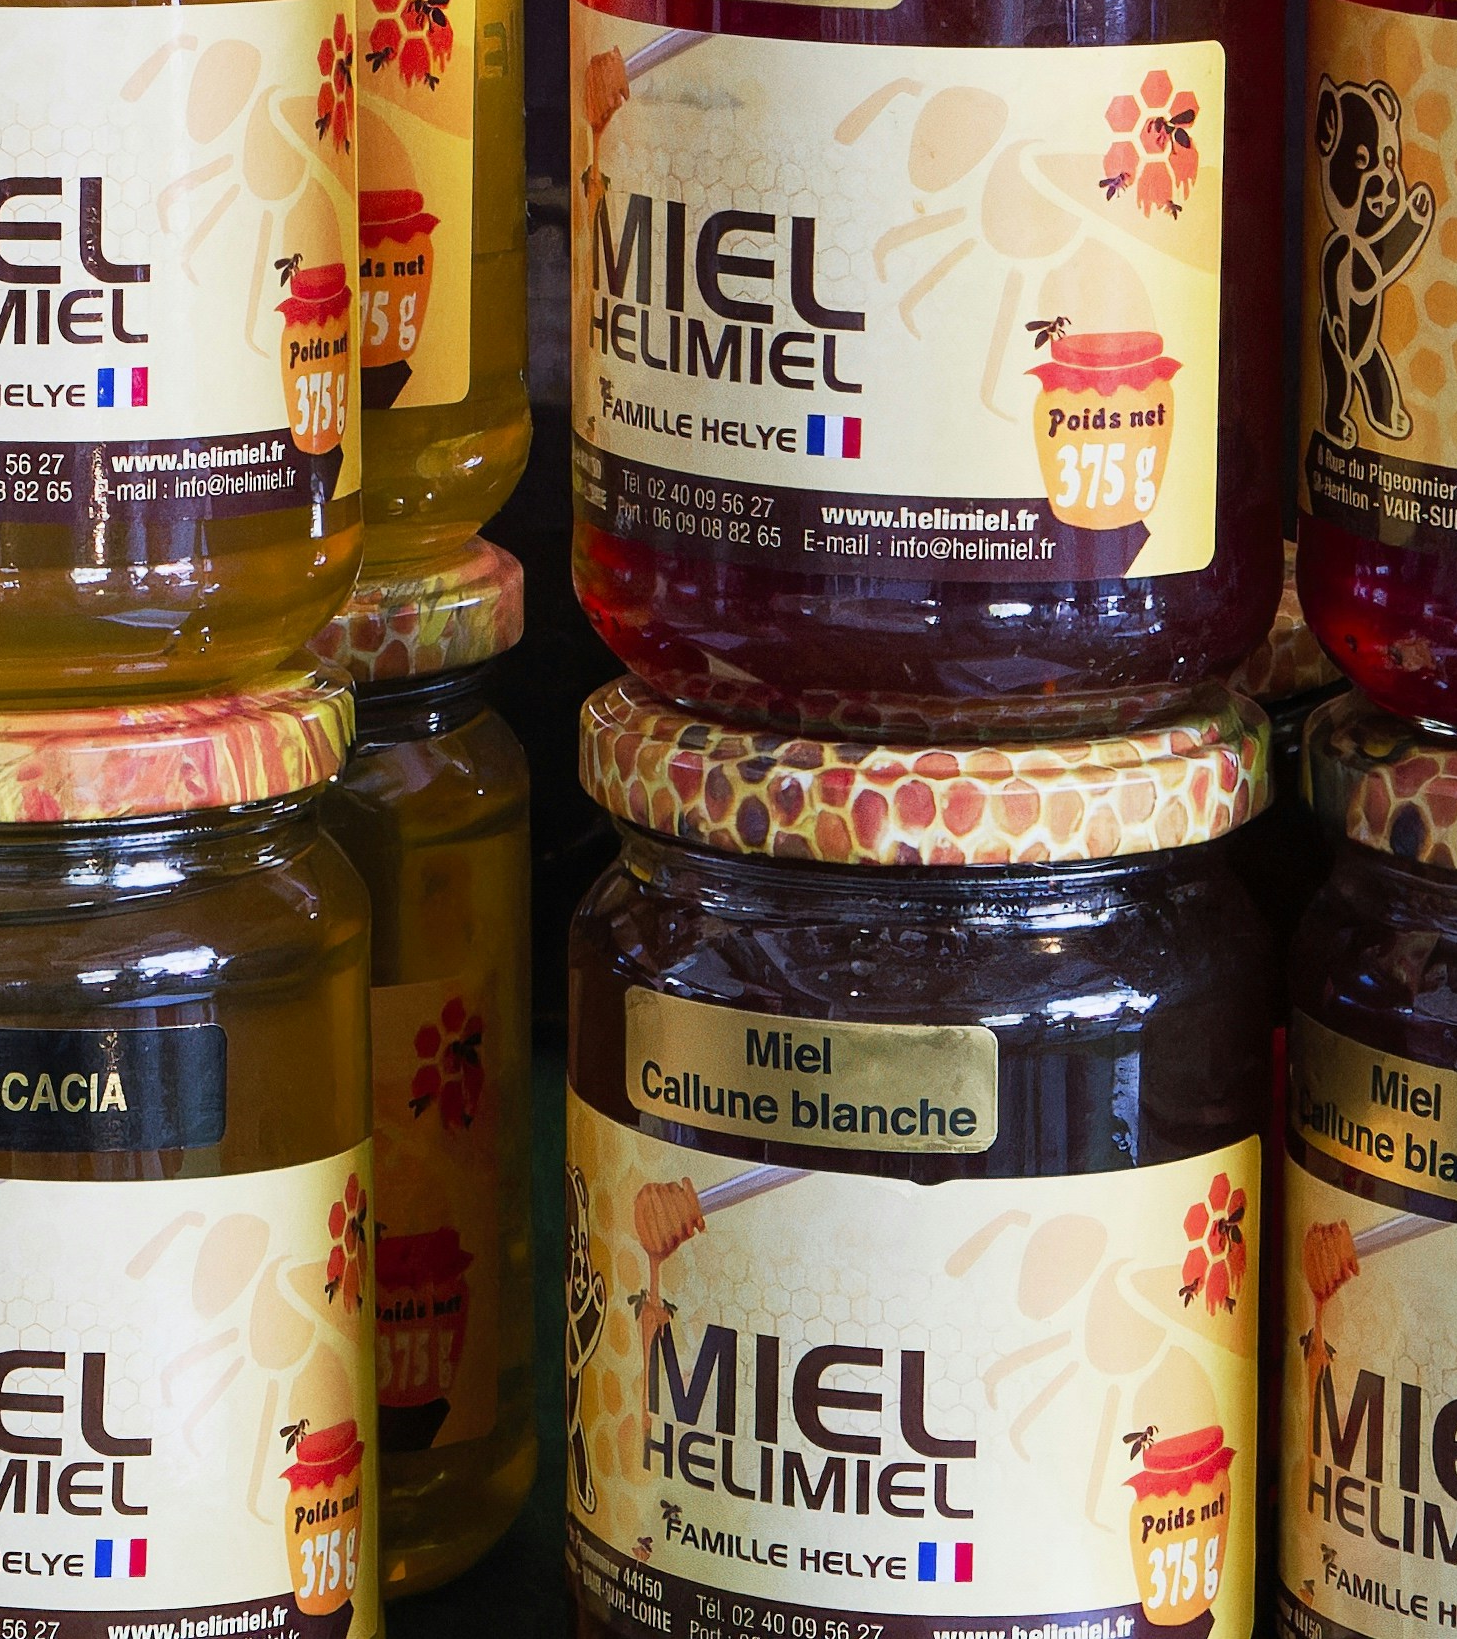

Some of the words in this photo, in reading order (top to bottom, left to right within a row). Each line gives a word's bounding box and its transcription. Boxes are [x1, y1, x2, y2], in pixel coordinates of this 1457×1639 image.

[593, 193, 865, 331] MIEL
[589, 298, 862, 394] HELIMIEL
[602, 395, 692, 440] FAMILLE
[703, 417, 796, 453] HELYE
[1049, 408, 1121, 438] Poids
[1130, 403, 1165, 429] net
[1055, 445, 1125, 509] 375
[1135, 444, 1156, 511] g
[821, 505, 1039, 532] www.helimiel.fr
[746, 1029, 832, 1074] Miel
[642, 1062, 778, 1123] Callune
[792, 1093, 977, 1136] blanche
[1371, 1064, 1441, 1121] Miel
[649, 1321, 977, 1460] MIEL
[642, 1429, 974, 1520] HELIMIEL
